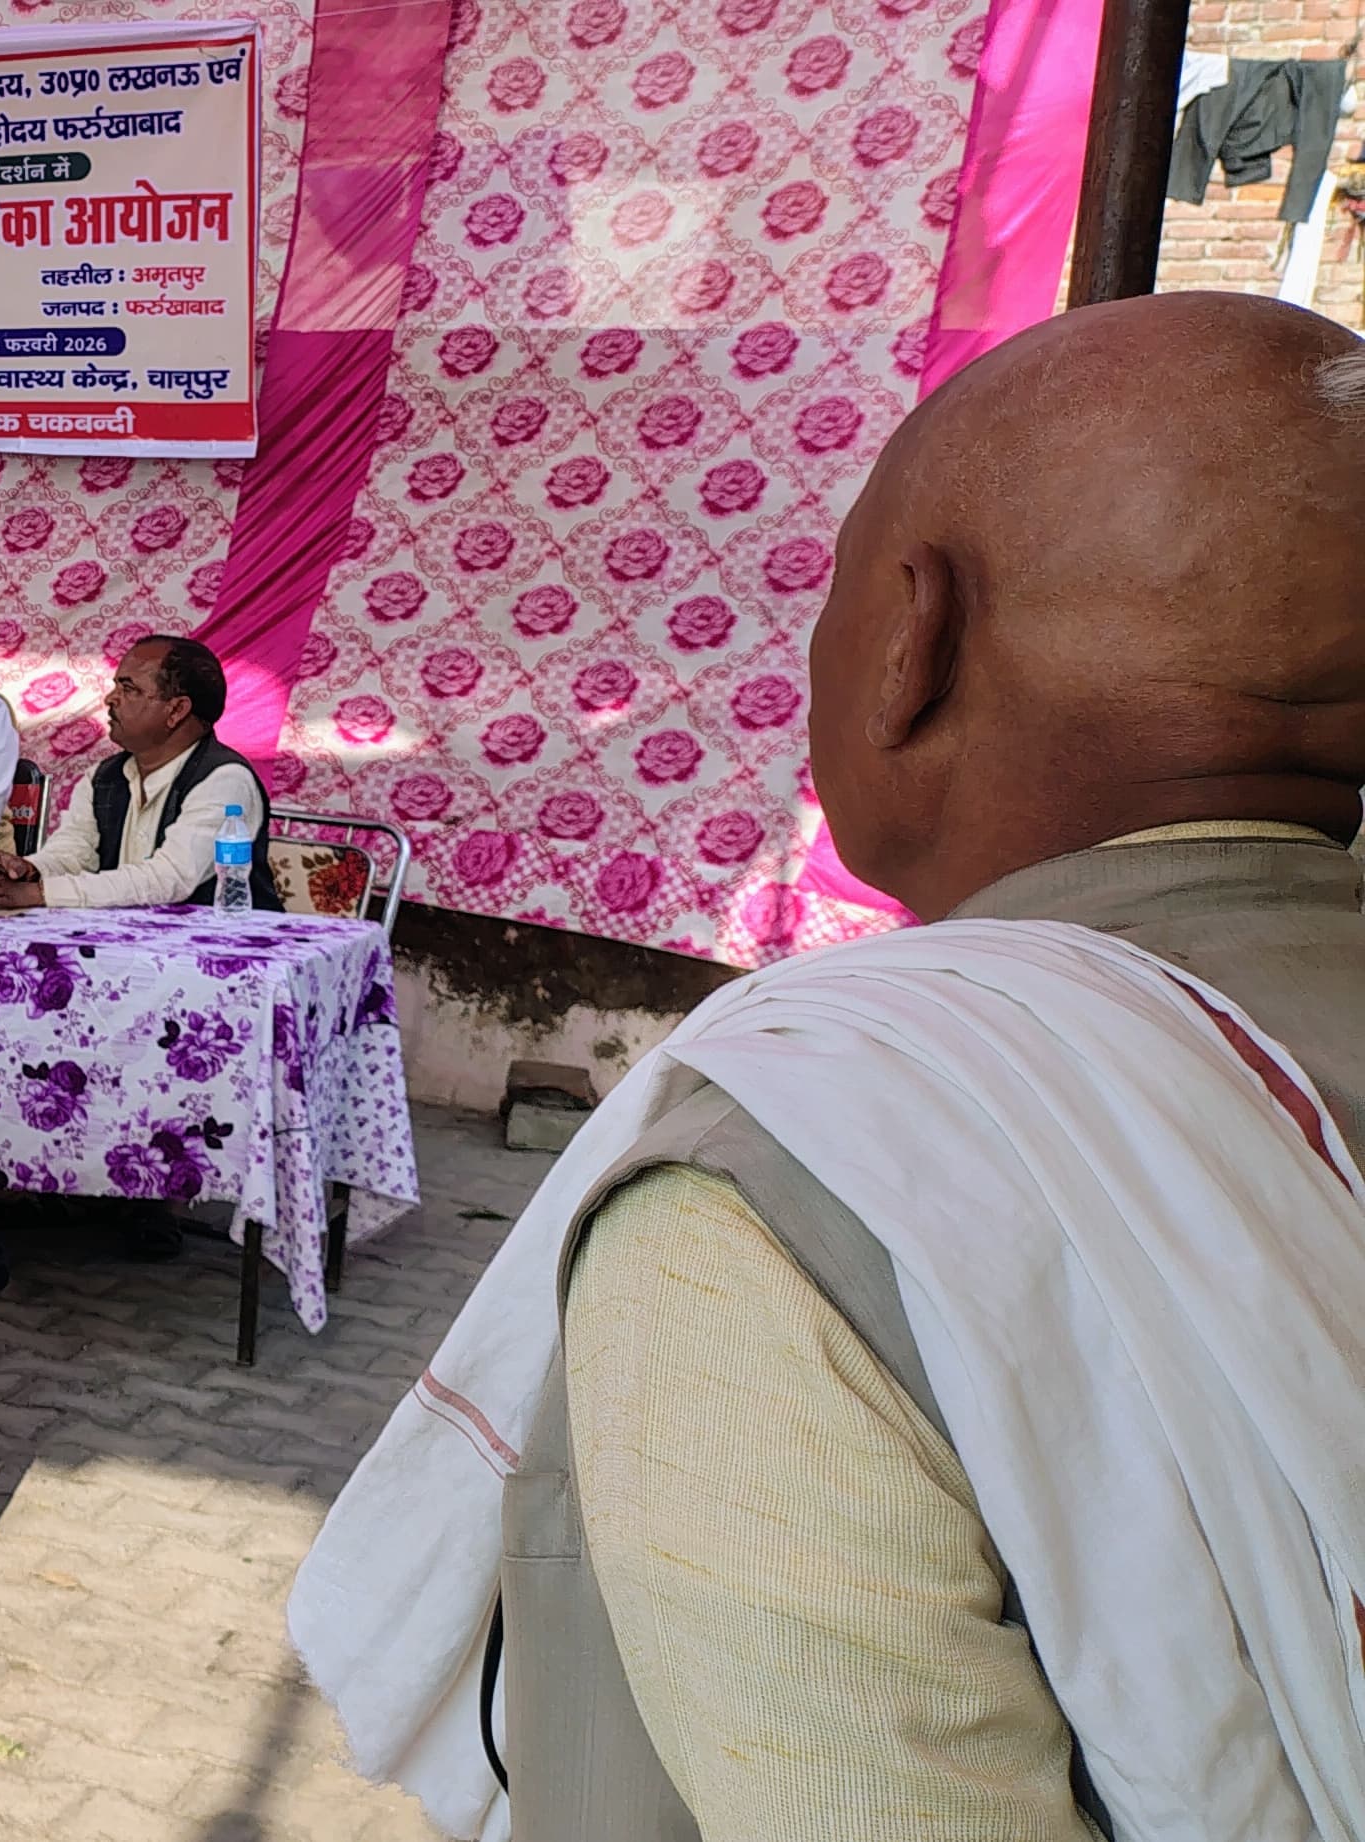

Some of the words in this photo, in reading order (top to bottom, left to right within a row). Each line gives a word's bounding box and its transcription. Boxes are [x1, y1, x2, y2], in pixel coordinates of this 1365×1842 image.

[107, 63, 200, 92] लखनऊ
[207, 48, 246, 84] एवं
[0, 157, 46, 182] दर्शन
[52, 156, 71, 178] में
[0, 200, 54, 247] का
[65, 180, 233, 245] आयोजन
[41, 263, 113, 286] तहसील
[132, 266, 206, 290] अमृतपुर
[42, 301, 106, 317] जनपद
[4, 333, 57, 352] फरवरी
[64, 337, 107, 352] 2026
[72, 362, 138, 392] केन्द्र,
[148, 369, 230, 399] चाचूपुर
[27, 407, 136, 434] चकबन्दी
